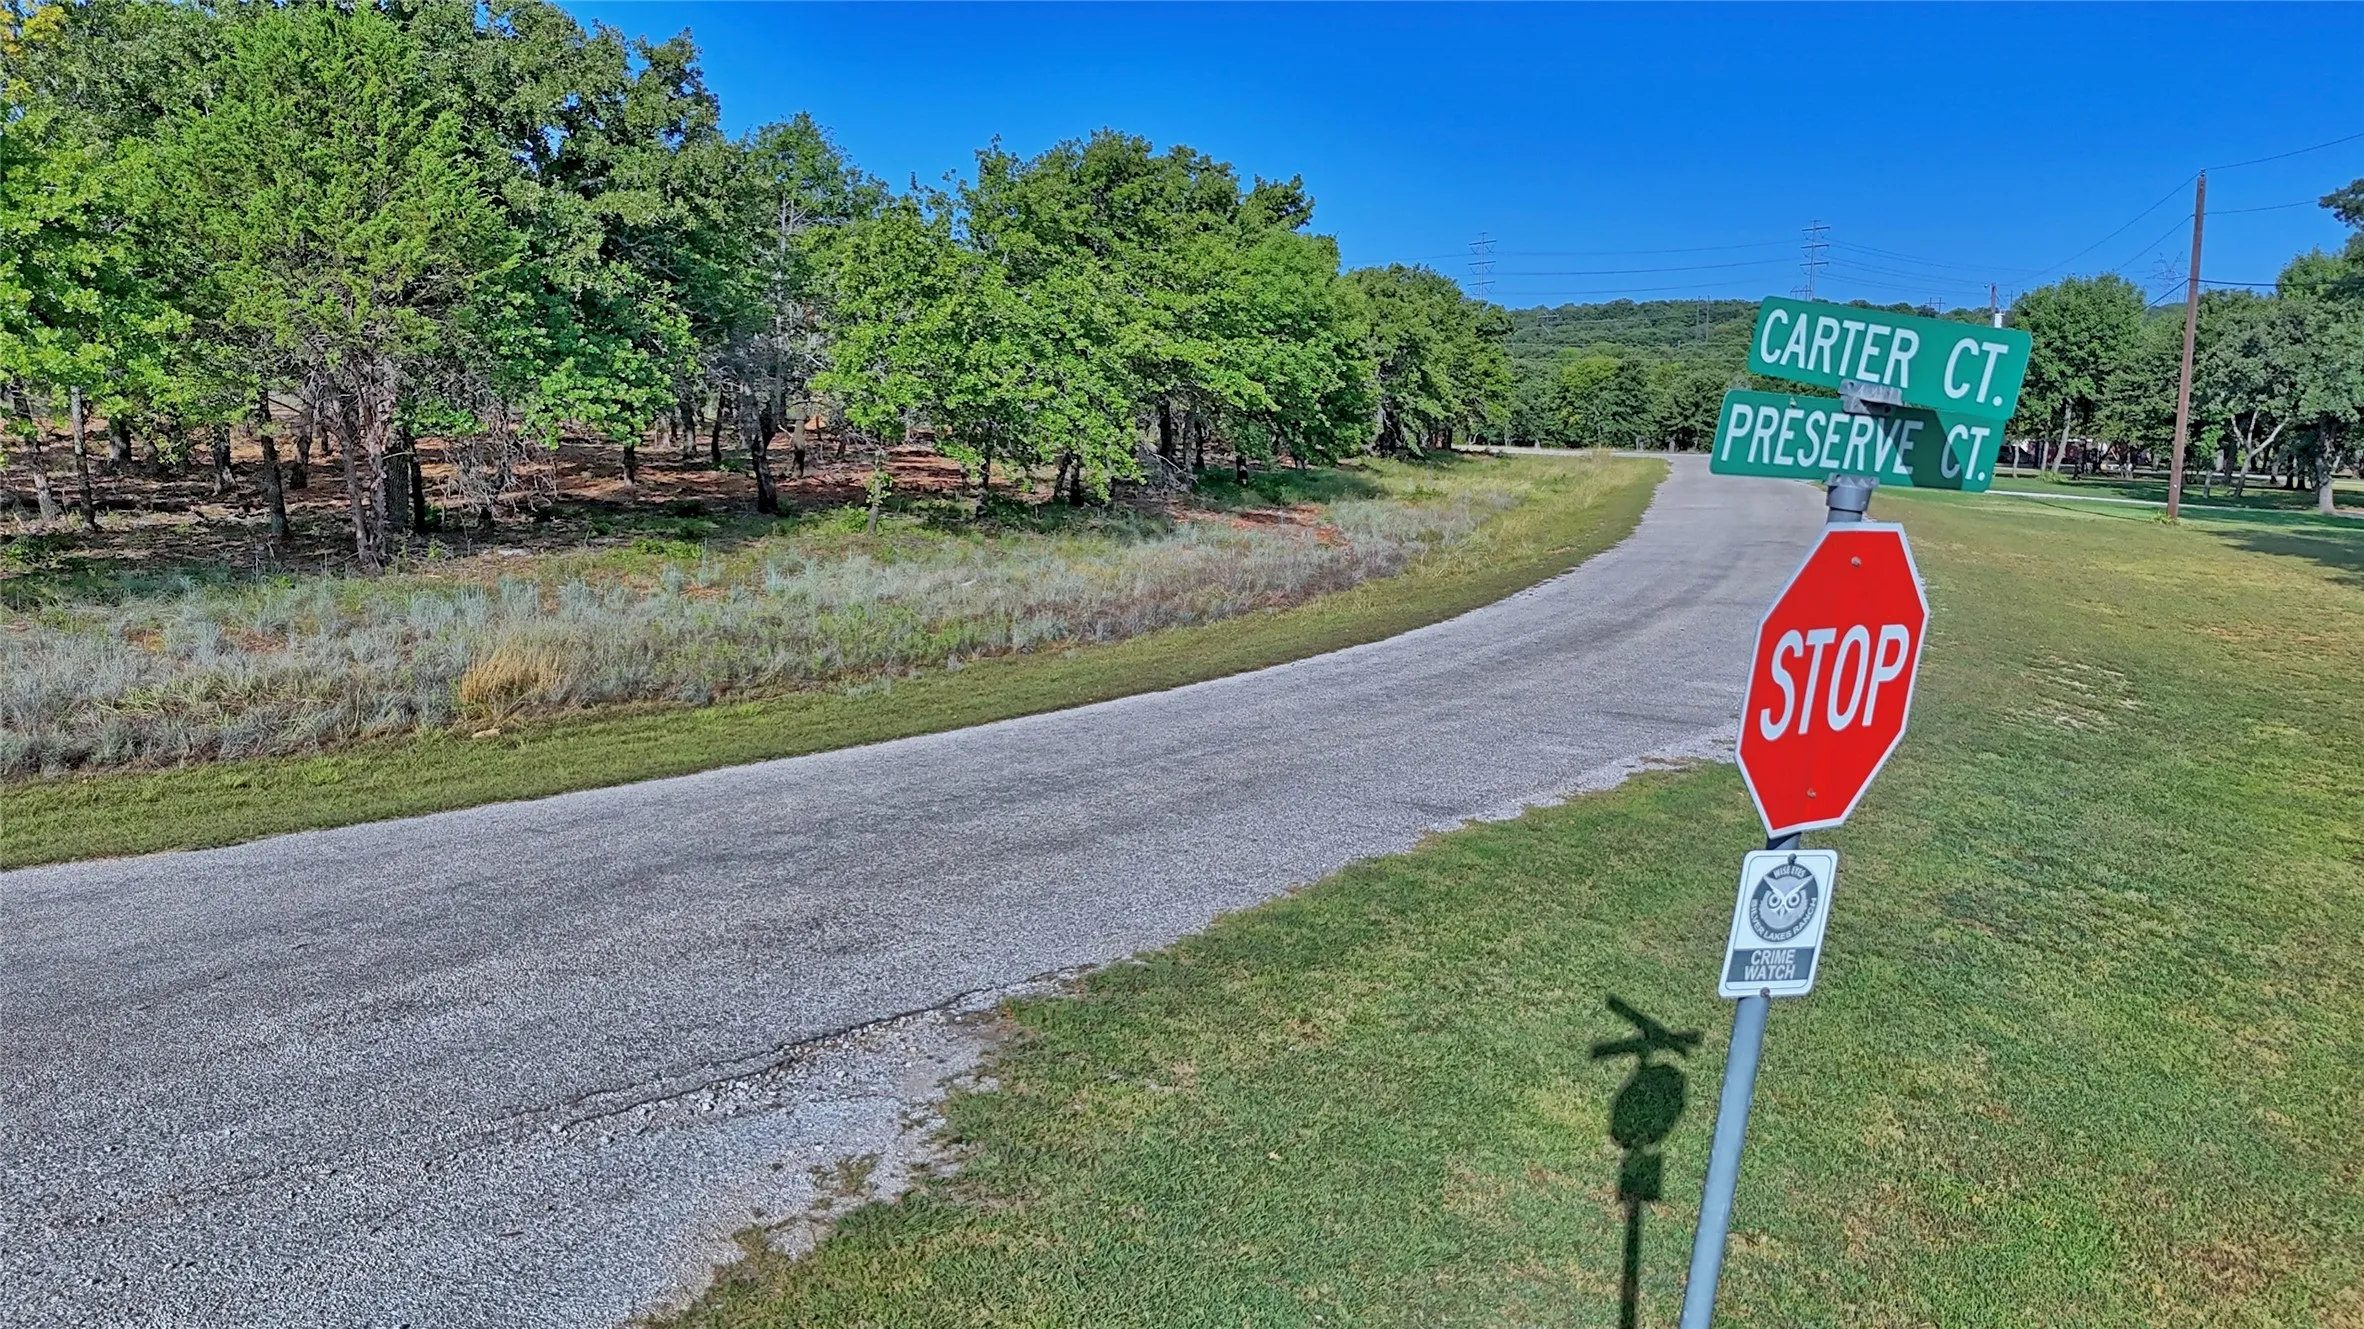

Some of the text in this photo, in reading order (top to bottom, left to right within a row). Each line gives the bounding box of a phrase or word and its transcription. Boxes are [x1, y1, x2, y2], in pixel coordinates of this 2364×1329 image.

[1759, 308, 2009, 407] CARTER CT.
[1720, 403, 1990, 482] PRESERVE CT.
[1760, 624, 1910, 741] STOP
[1774, 865, 1806, 878] WISE EYES
[1763, 931, 1792, 941] LAKES
[1793, 897, 1817, 935] RANCH
[1745, 965, 1796, 980] WATCH
[1751, 949, 1796, 965] CRIME
